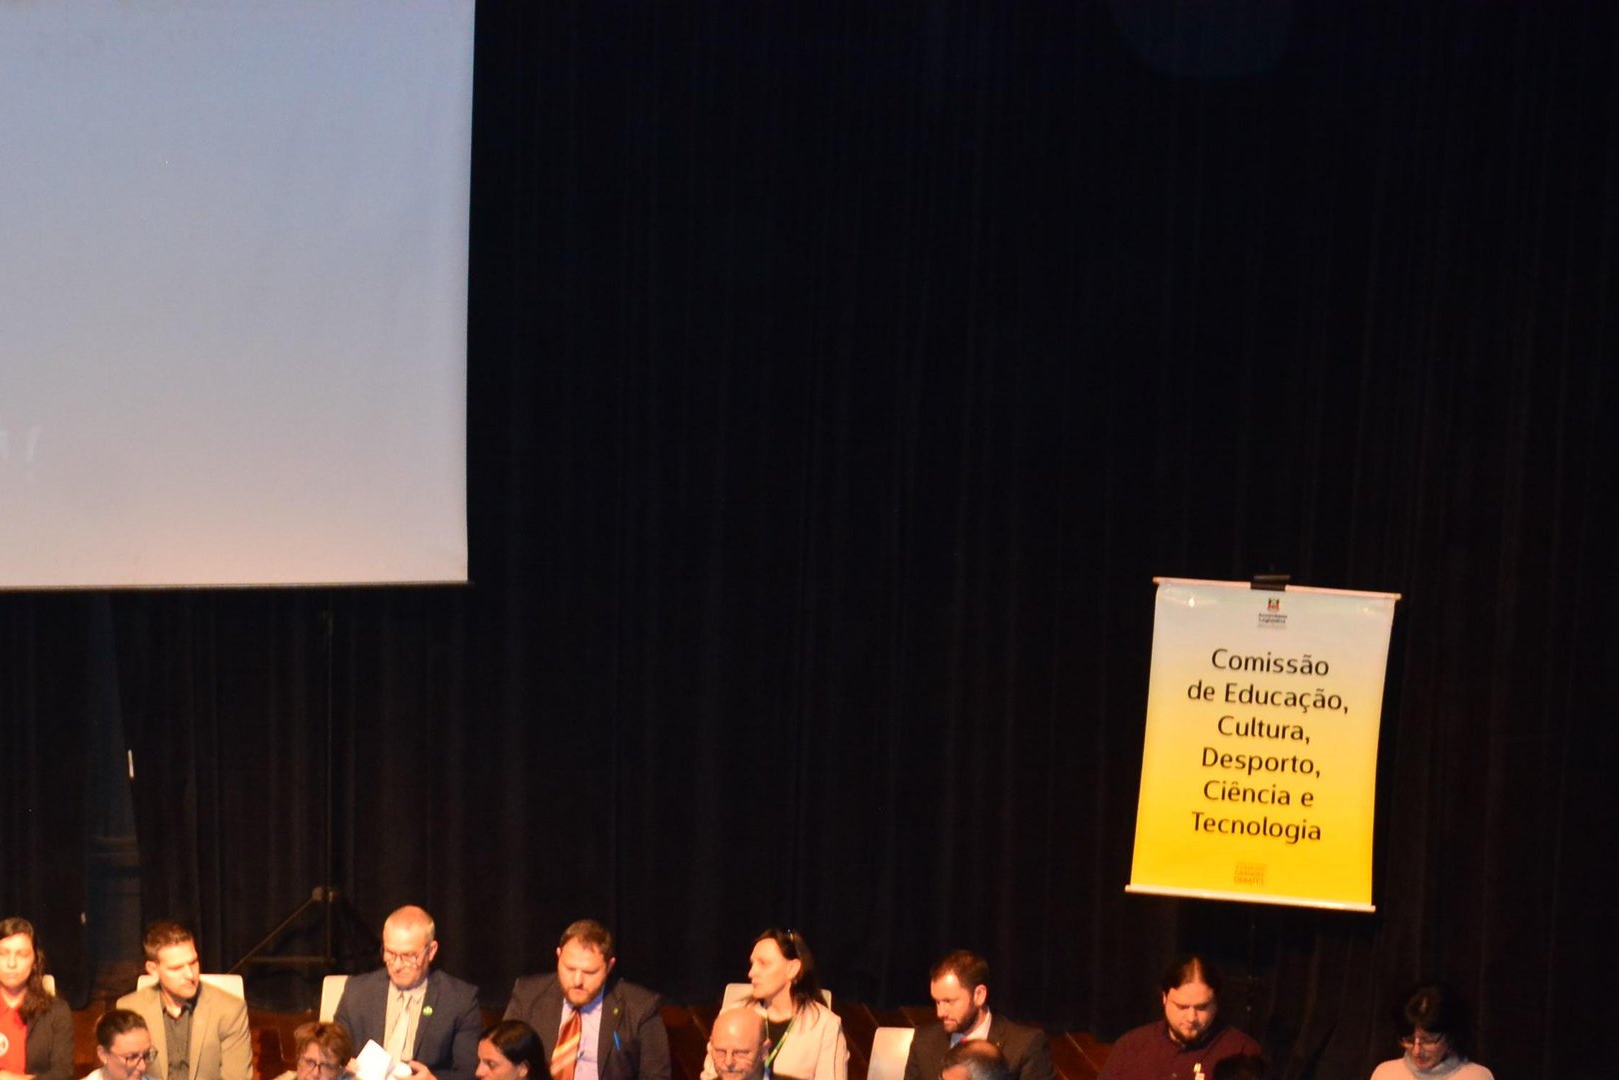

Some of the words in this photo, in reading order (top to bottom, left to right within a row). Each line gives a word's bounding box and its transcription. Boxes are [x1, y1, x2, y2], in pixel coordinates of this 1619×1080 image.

[1211, 648, 1330, 676] Comissão
[1187, 679, 1216, 702] de
[1224, 682, 1349, 714] Educação,
[1217, 715, 1311, 744] Cultura,
[1201, 747, 1321, 778] Desporto,
[1202, 780, 1291, 806] Ciência
[1300, 791, 1314, 807] e
[1190, 811, 1322, 844] Tecnologia
